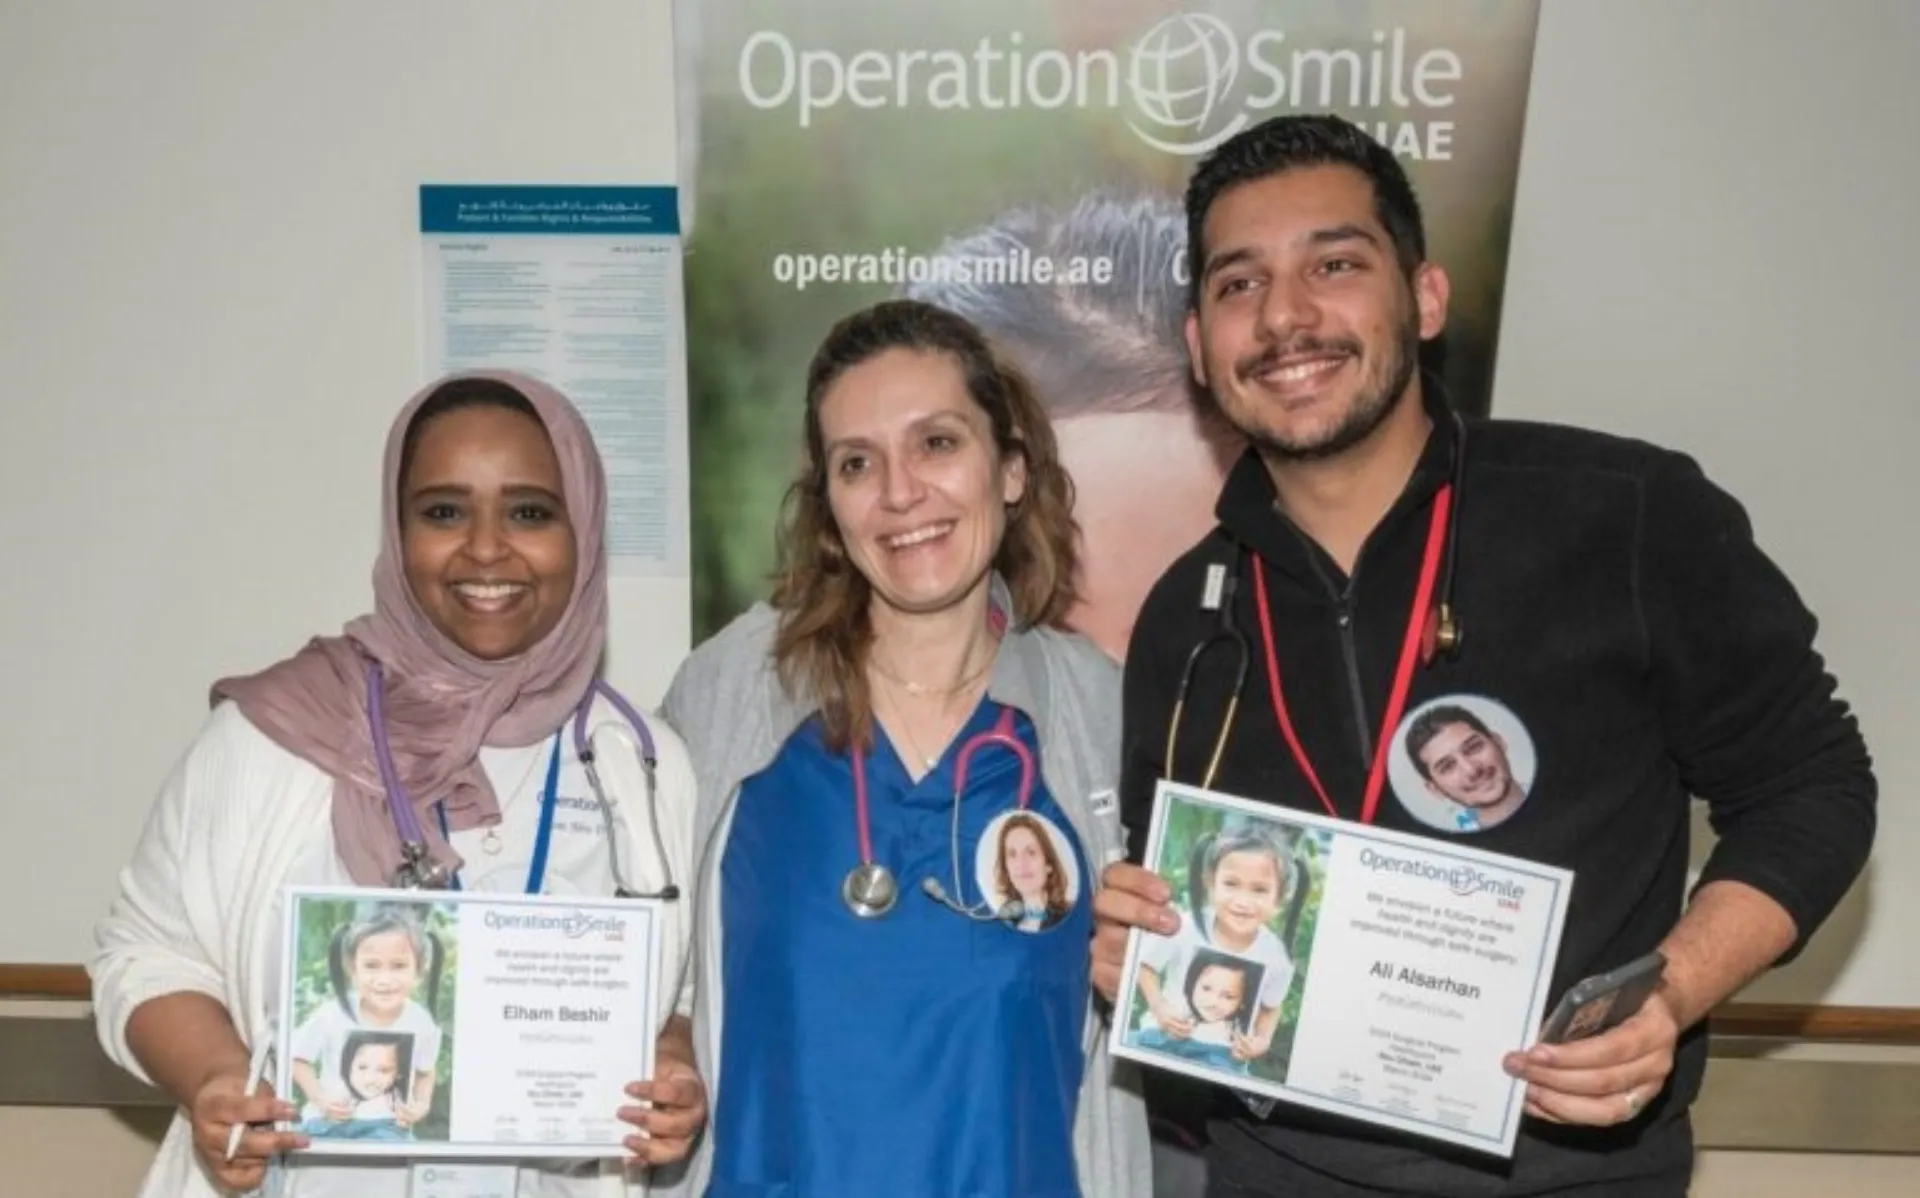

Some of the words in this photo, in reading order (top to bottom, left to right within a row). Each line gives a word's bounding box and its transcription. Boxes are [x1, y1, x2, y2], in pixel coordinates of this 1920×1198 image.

[739, 30, 1119, 127] Operation
[1246, 26, 1462, 108] Smile
[773, 247, 1113, 290] operationsmile.ae
[1359, 847, 1449, 881] Operation
[1476, 872, 1525, 899] Smile
[484, 911, 567, 932] Operation
[1370, 961, 1393, 980] Ali
[1397, 967, 1480, 999] Alsarhan
[503, 1004, 555, 1021] Elham
[558, 1004, 611, 1023] Beshir
